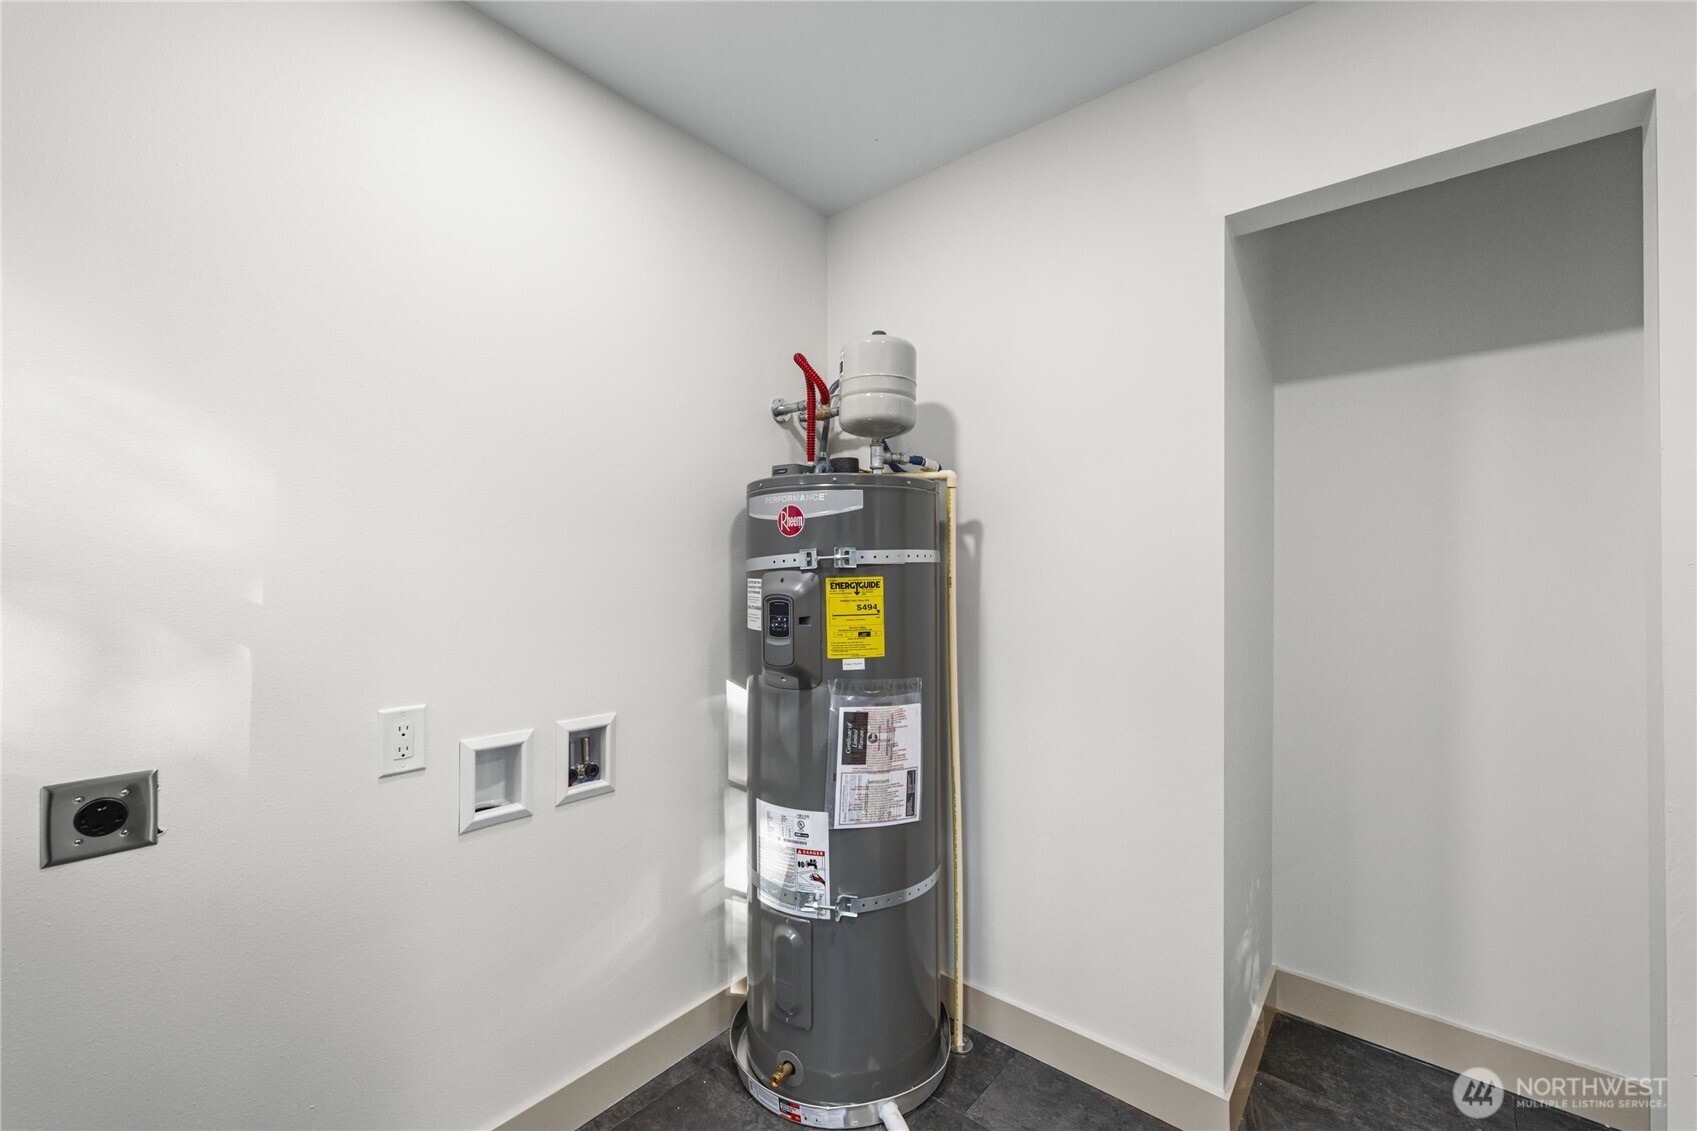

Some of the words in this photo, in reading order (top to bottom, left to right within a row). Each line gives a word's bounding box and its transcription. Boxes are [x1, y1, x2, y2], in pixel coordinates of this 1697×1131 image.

[765, 493, 826, 504] PERFORMANCE
[780, 505, 803, 531] Rheem
[856, 603, 878, 611] $494
